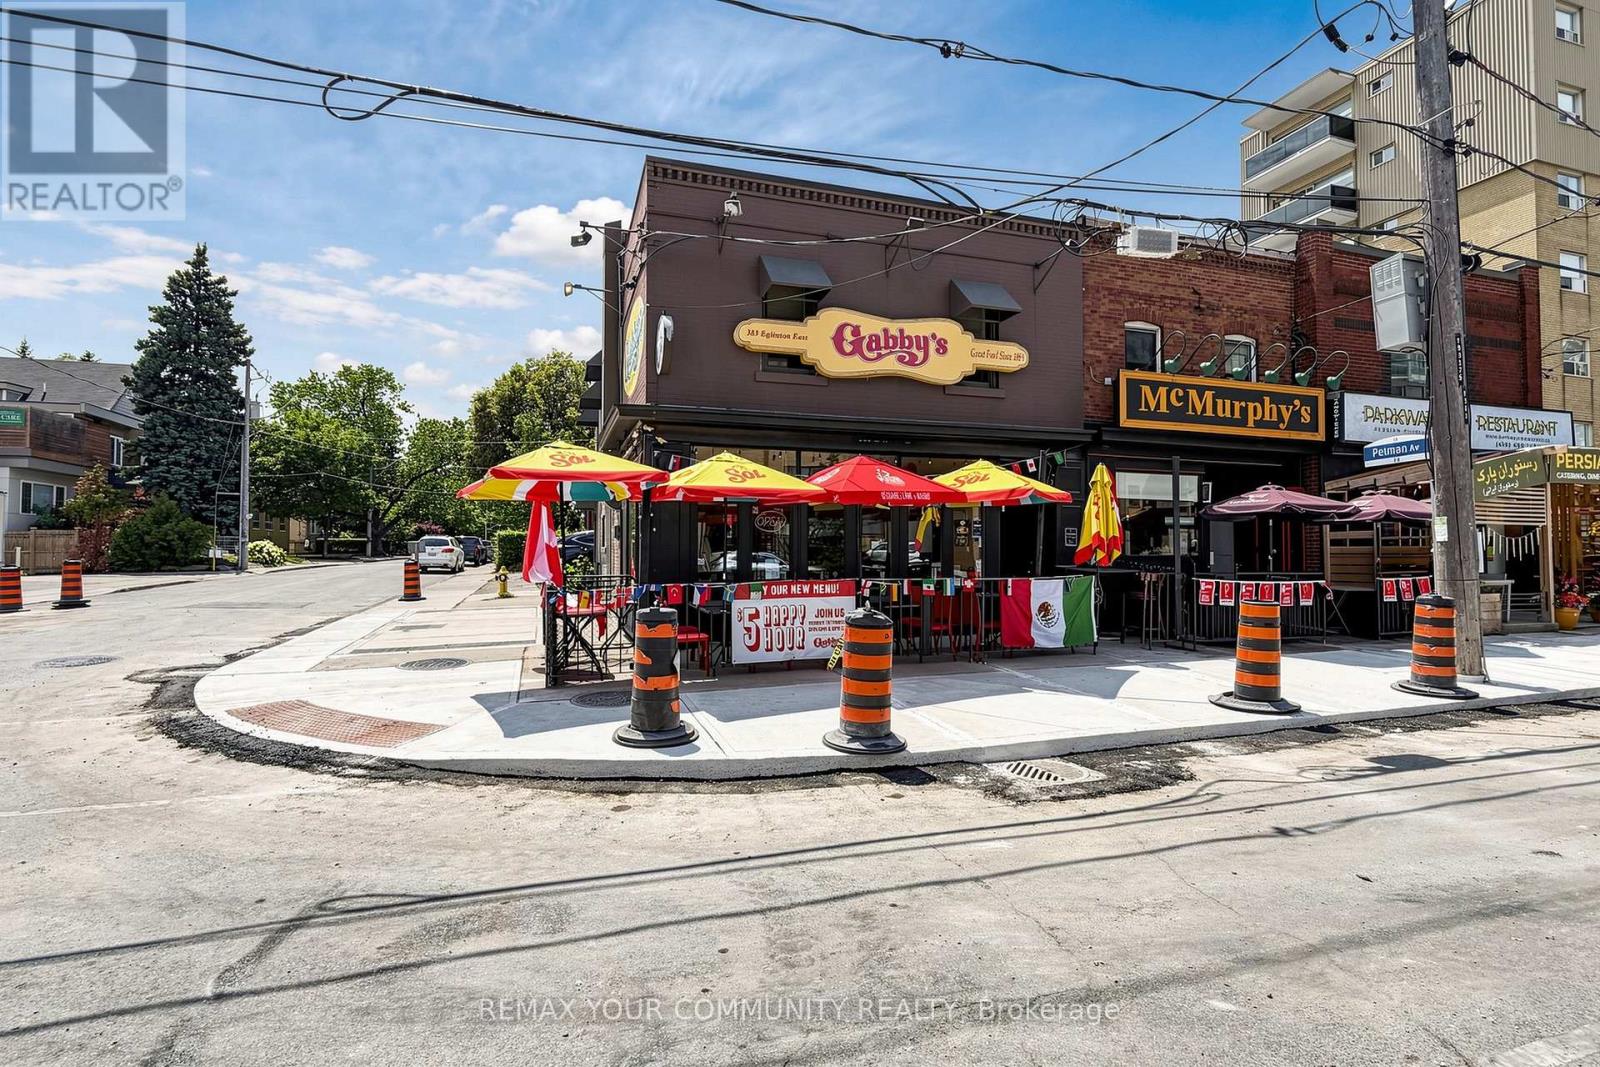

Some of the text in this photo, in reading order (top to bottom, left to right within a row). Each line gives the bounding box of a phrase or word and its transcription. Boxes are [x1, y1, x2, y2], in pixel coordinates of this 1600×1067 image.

[830, 321, 948, 368] Gabby's
[1138, 384, 1311, 430] McMurphy's
[1362, 404, 1429, 426] PARKWA
[1475, 415, 1558, 436] RESTAURANT
[1372, 444, 1420, 458] Petman Av
[771, 584, 788, 595] OUR
[790, 584, 811, 595] NEW
[813, 583, 840, 594] MENU!
[764, 604, 807, 627] HAPPY
[814, 608, 845, 618] JOIN US
[764, 626, 806, 652] HOUR
